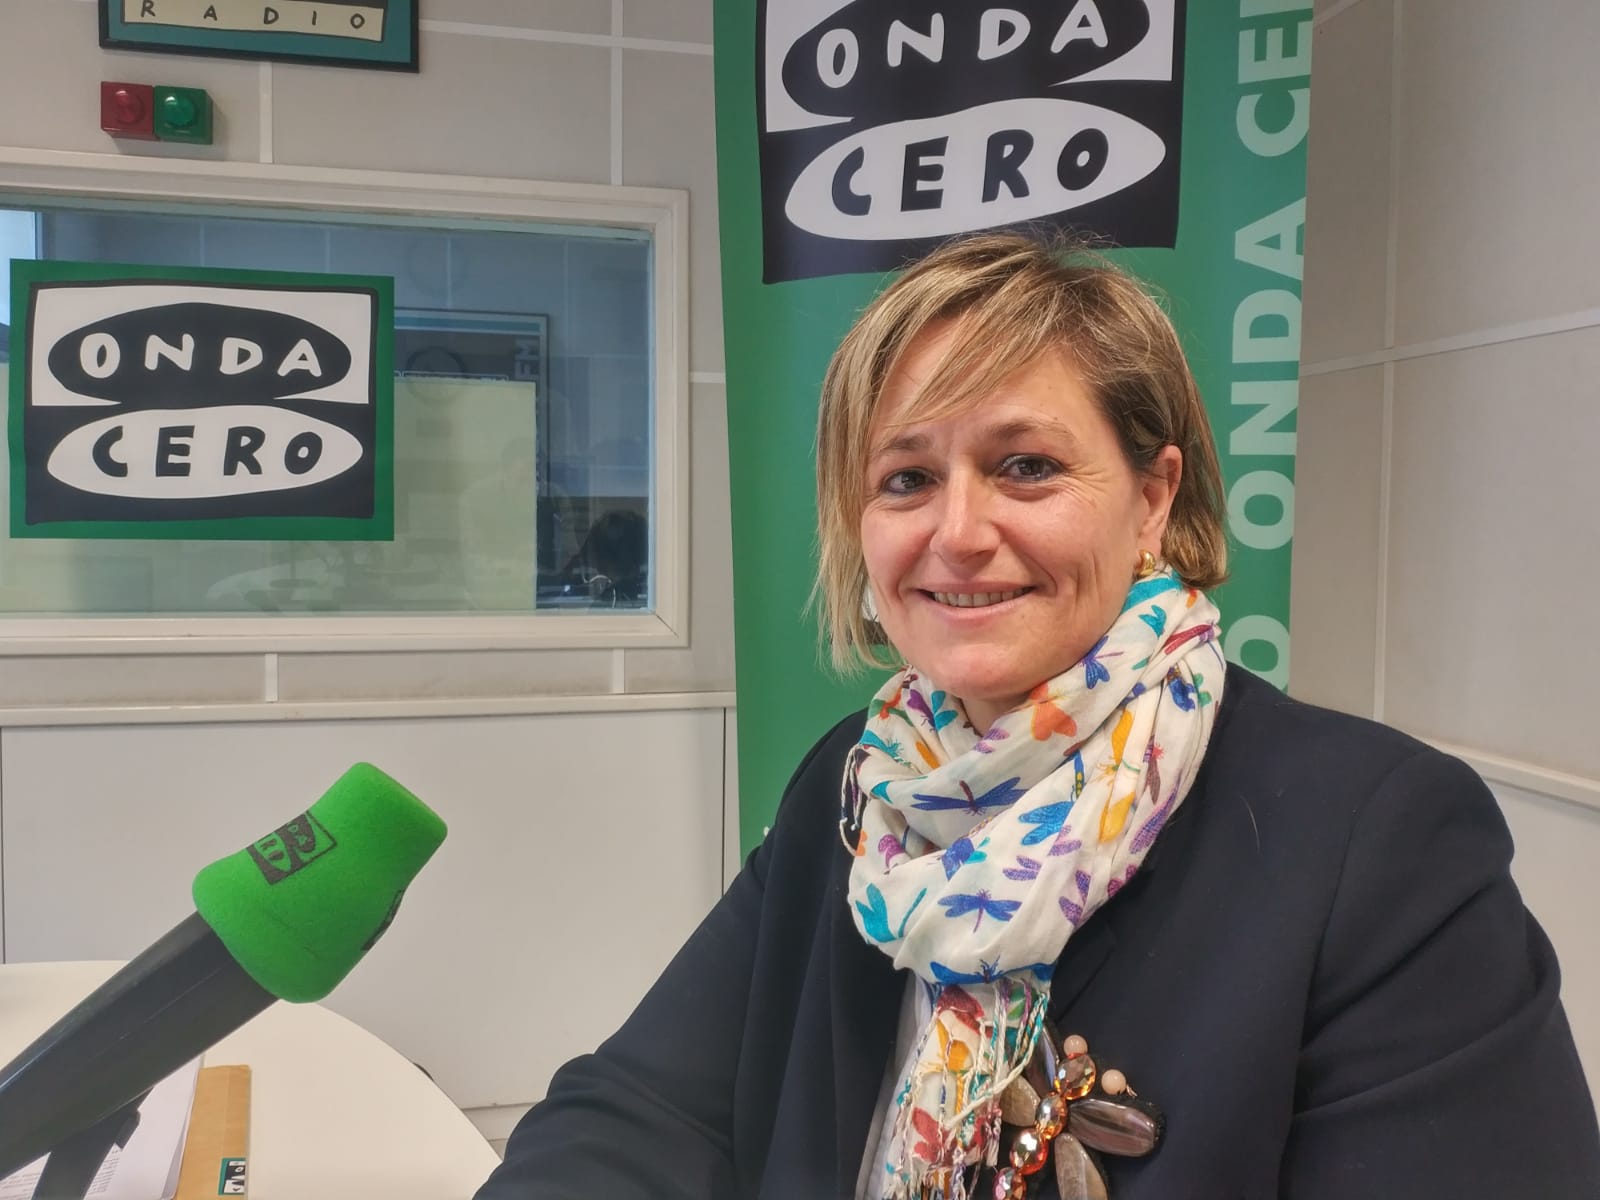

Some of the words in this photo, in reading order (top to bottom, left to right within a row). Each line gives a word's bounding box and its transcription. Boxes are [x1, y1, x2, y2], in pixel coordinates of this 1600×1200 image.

[140, 0, 366, 30] RADIO
[816, 0, 1109, 89] ONDA
[831, 127, 1109, 217] CERO
[79, 332, 322, 379] ONDA
[1228, 197, 1307, 550] ONDA
[92, 425, 323, 478] CERO
